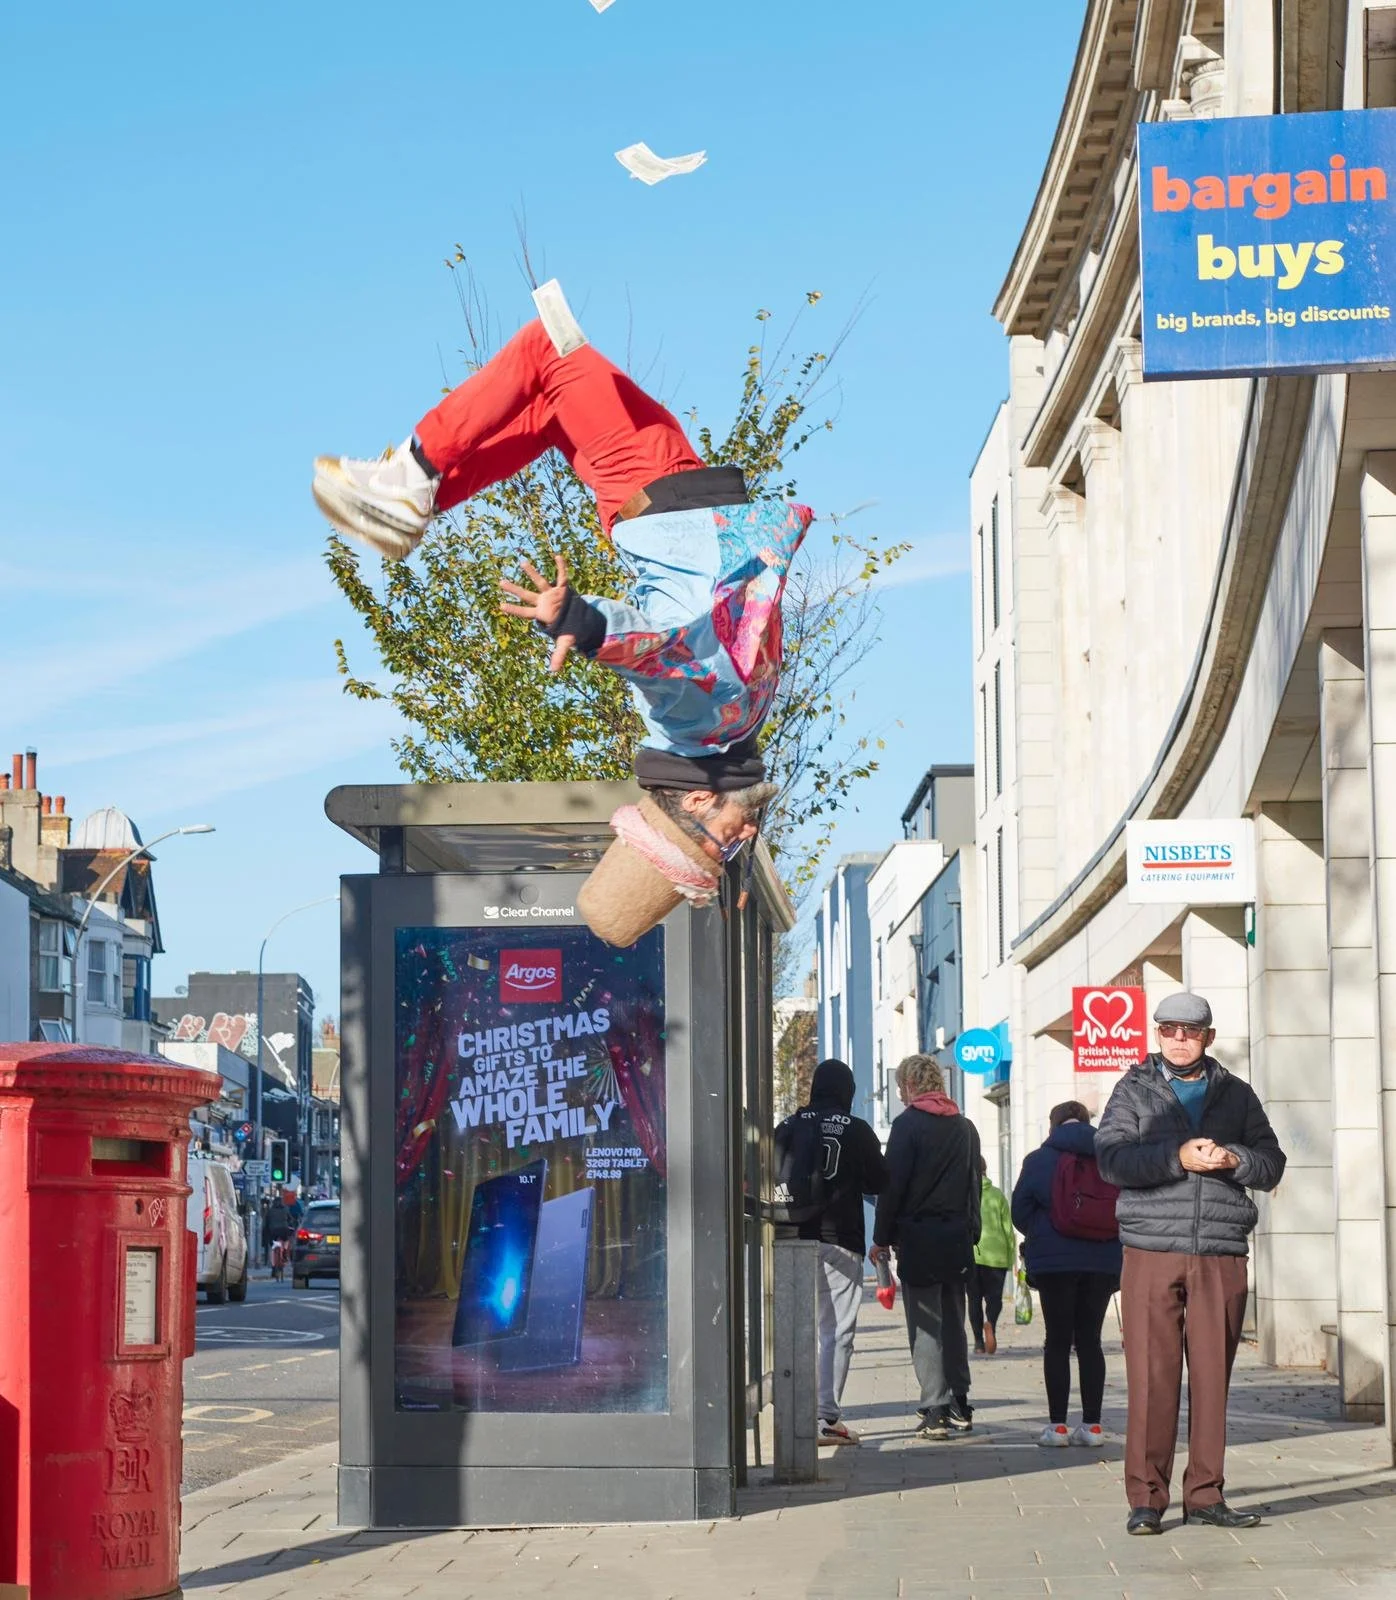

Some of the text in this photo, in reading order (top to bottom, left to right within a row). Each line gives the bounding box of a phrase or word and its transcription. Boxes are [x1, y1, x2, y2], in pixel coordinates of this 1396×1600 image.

[1152, 154, 1387, 219] bargain
[1197, 234, 1345, 290] buys
[1157, 304, 1391, 333] big brands, big discounts
[1145, 844, 1232, 861] NISBETS
[1140, 872, 1235, 882] CATERING EQUIPMENT
[500, 905, 574, 917] Clear Channel
[505, 963, 556, 983] Argos
[457, 1008, 610, 1058] CHRISTMAS
[474, 1043, 553, 1073] GIFTS TO
[961, 1045, 995, 1062] gym
[1078, 1046, 1139, 1056] British Heart
[1078, 1056, 1139, 1067] Foundation
[459, 1055, 588, 1099] AMAZE THE
[450, 1081, 568, 1130] WHOLE
[506, 1101, 615, 1149] FAMILY
[585, 1147, 642, 1157] LENOVO M10
[586, 1158, 649, 1168] 32GB TABLET
[586, 1169, 622, 1179] £149.99
[92, 1510, 160, 1540] ROYAL
[100, 1541, 154, 1570] MAIL
